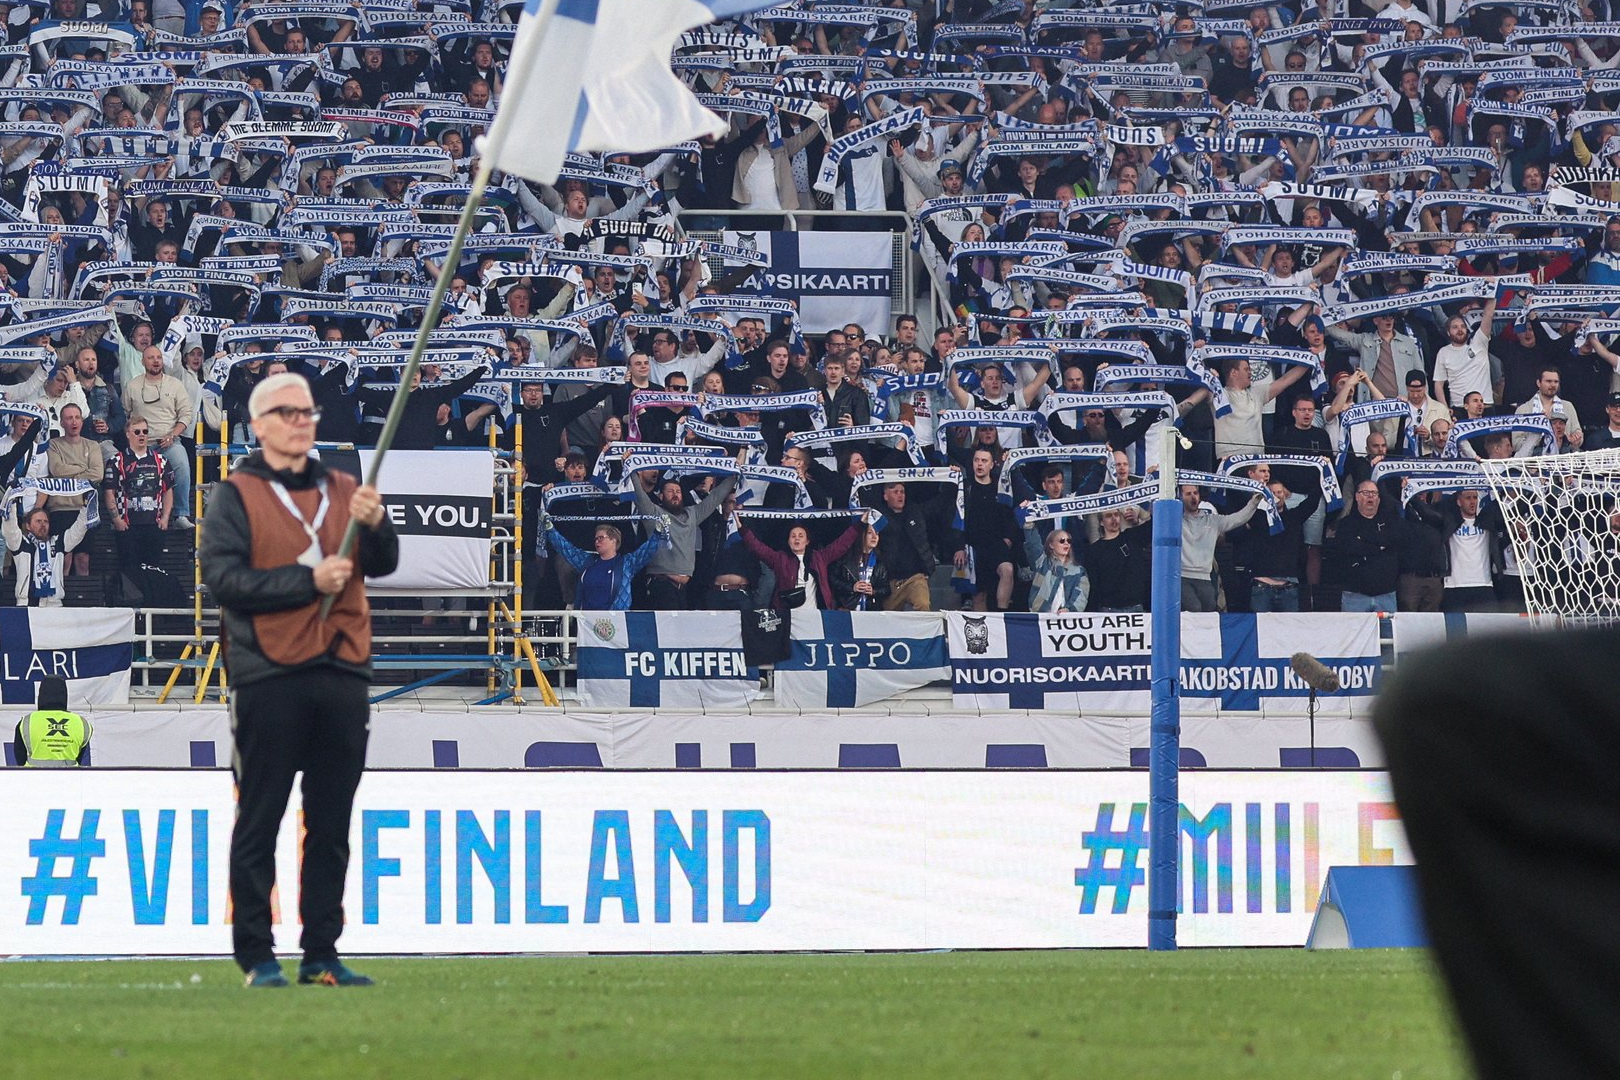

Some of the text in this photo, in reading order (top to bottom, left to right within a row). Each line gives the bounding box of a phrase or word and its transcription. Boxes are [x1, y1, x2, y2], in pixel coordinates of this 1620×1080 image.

[60, 21, 107, 35] SUOMI
[231, 124, 248, 140] ME
[988, 142, 1079, 152] SUOMI FINLAND
[1195, 137, 1264, 154] SUOMI
[1236, 231, 1351, 240] POHJOISKAARRE
[736, 274, 889, 290] APSIKAARTI
[1351, 286, 1467, 314] POHJOISKAARRE
[1058, 393, 1166, 405] POHJOISKAARRE
[792, 424, 904, 444] SUOMI FINLAND
[626, 455, 739, 469] POHJOISKAARRE
[39, 478, 76, 492] SUOMI
[1060, 487, 1159, 511] SUOMI FINLAND
[414, 505, 487, 528] YOU.
[1101, 615, 1144, 628] ARE
[1047, 633, 1152, 651] YOUTH.
[625, 652, 747, 677] FC KIFFEN
[955, 665, 1152, 684] NUORISOKAARTI
[1180, 666, 1278, 690] AKOBSTAD
[21, 809, 771, 925] #VIFINLAND
